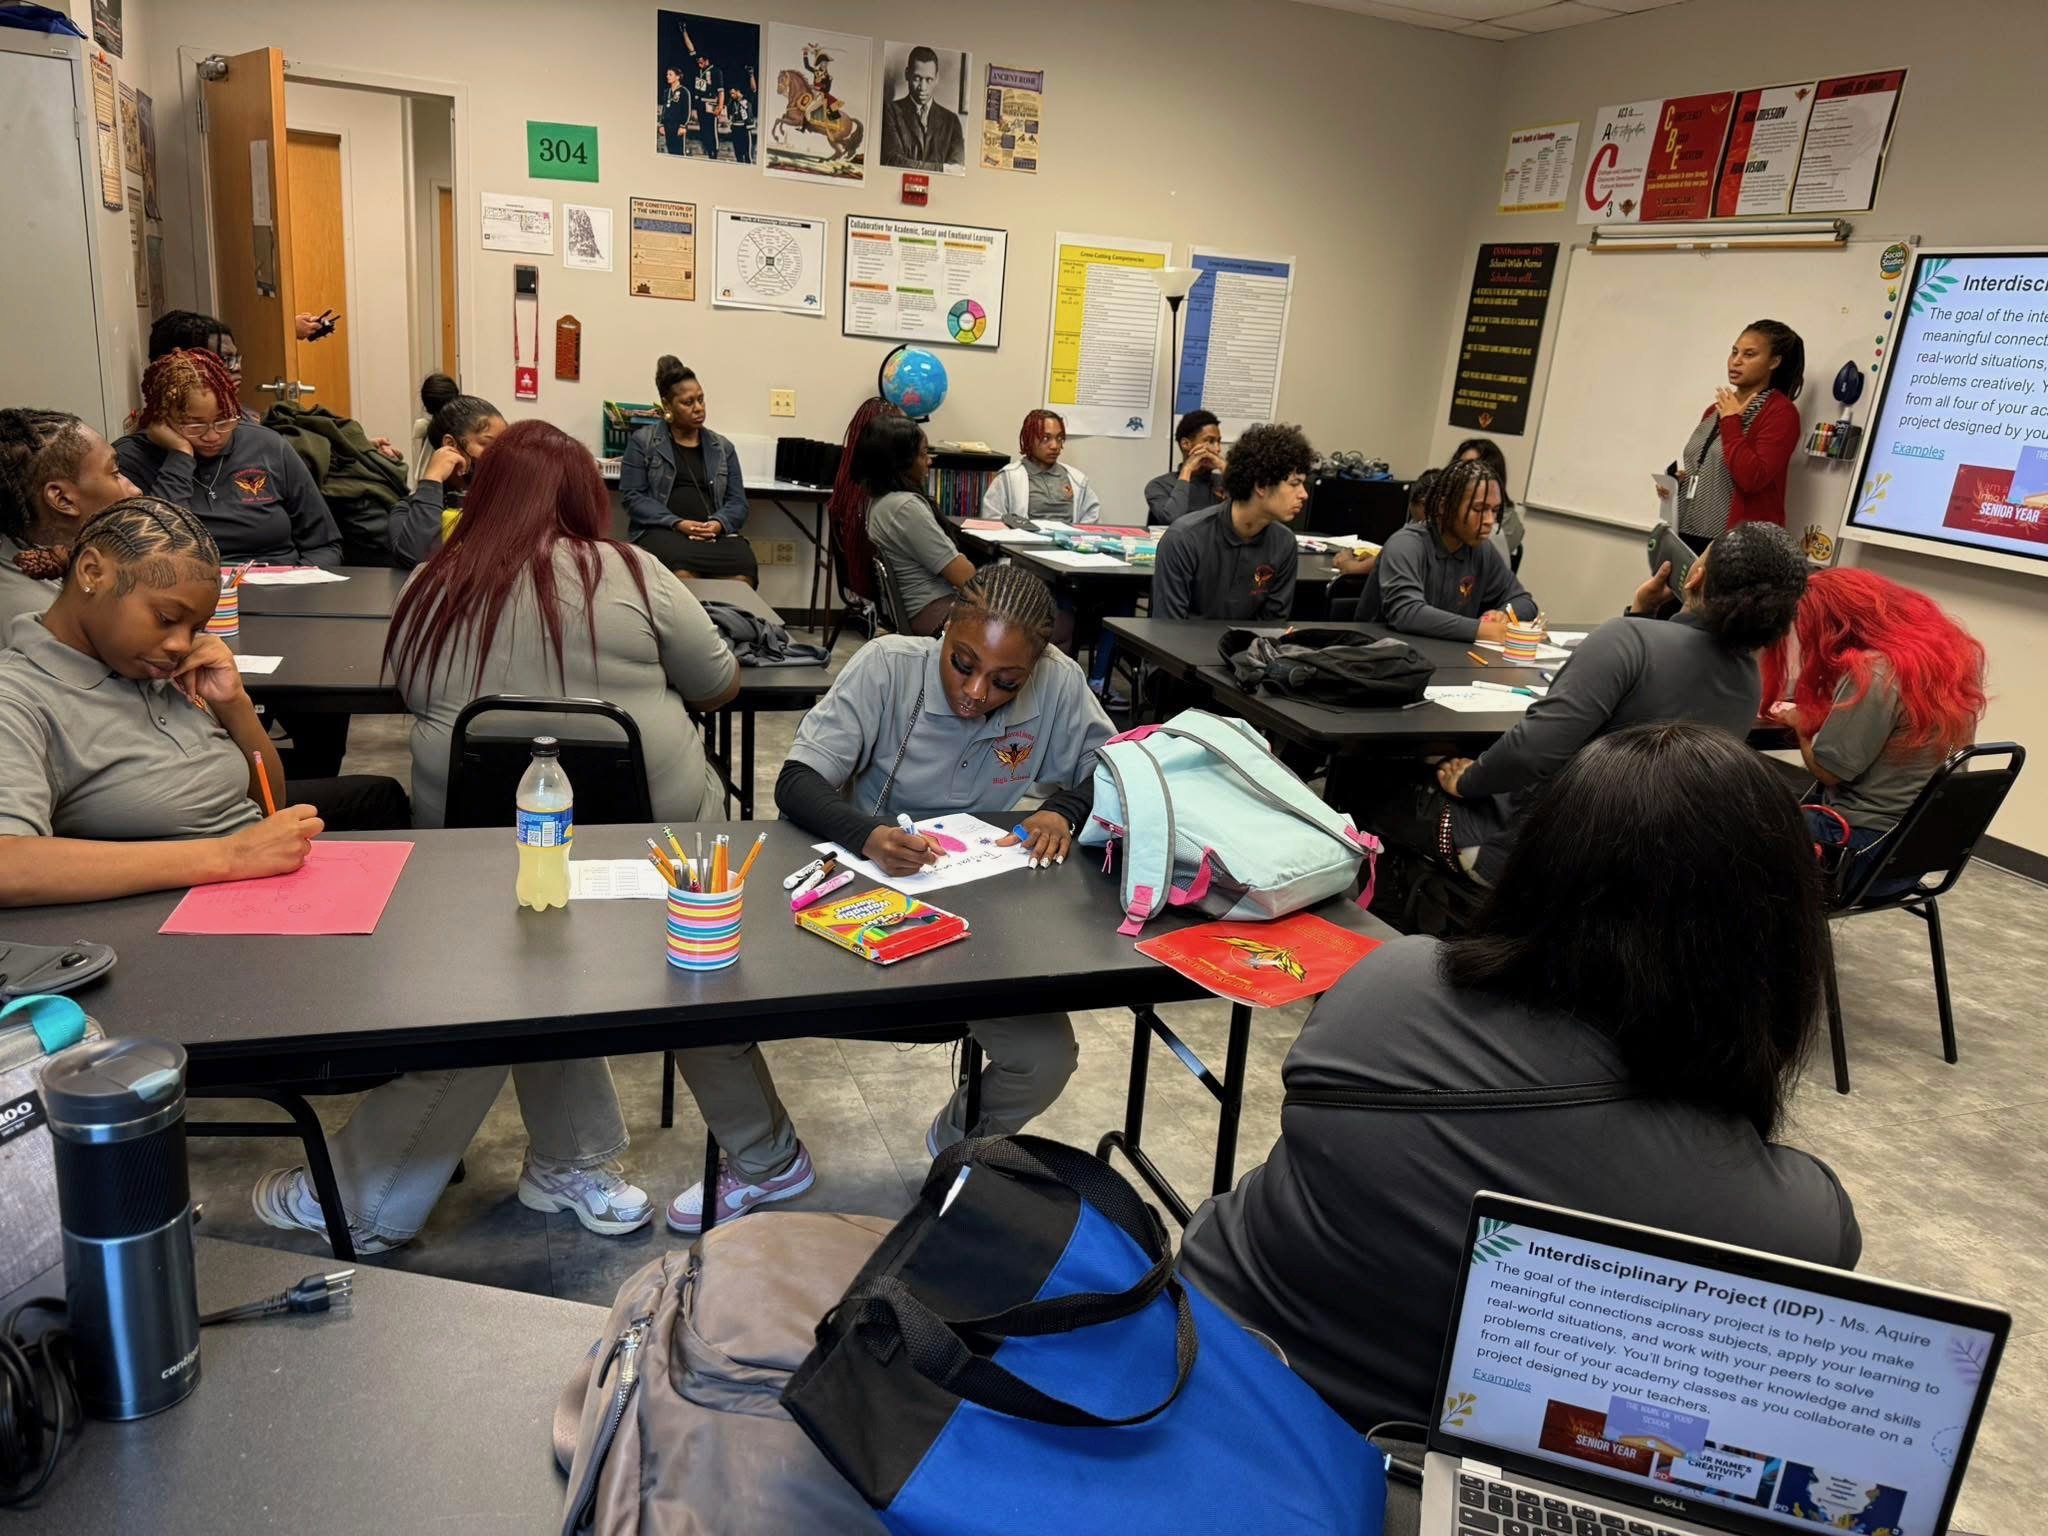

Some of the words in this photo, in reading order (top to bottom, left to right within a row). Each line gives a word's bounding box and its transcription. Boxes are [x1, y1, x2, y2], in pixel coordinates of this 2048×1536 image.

[1756, 106, 1788, 121] MISSION
[540, 138, 588, 165] 304
[1745, 160, 1768, 173] VISION
[850, 220, 884, 232] Collaborative
[894, 225, 920, 236] Academic,
[922, 228, 936, 236] Social
[938, 230, 946, 238] and
[948, 230, 972, 240] Emotional
[973, 233, 994, 244] Learning
[1112, 254, 1144, 263] Competencies
[1930, 306, 1952, 320] The
[1955, 308, 1984, 323] goal
[1987, 308, 2000, 322] of
[2003, 310, 2024, 322] the
[1922, 330, 1992, 346] meaningful
[1995, 333, 2048, 346] connect
[1916, 352, 1978, 366] real-world
[1981, 354, 2048, 371] situations,
[1910, 372, 1967, 386] problems
[1970, 375, 2036, 394] creatively.
[1905, 392, 1932, 406] from
[1936, 394, 1950, 408] all
[1953, 395, 1978, 410] four
[1982, 399, 1995, 411] of
[1996, 402, 2028, 416] your
[2030, 405, 2048, 416] ac
[1899, 416, 1941, 429] project
[1944, 419, 2002, 434] designed
[2005, 424, 2022, 440] by
[1891, 441, 1946, 460] Examples
[1980, 502, 2014, 520] SENIOR
[2015, 507, 2040, 522] YEAR
[1528, 1242, 1688, 1293] Interdisciplinary
[1694, 1280, 1768, 1310] Project
[1773, 1298, 1824, 1325] (IDP)
[1840, 1316, 1869, 1334] Ms.
[1875, 1325, 1931, 1347] Aquire
[1495, 1261, 1520, 1276] The
[1524, 1268, 1554, 1284] goal
[1558, 1277, 1572, 1288] of
[1576, 1281, 1596, 1294] the
[1600, 1286, 1710, 1325] interdisciplinary
[1714, 1314, 1764, 1334] project
[1768, 1326, 1780, 1338] is
[1786, 1330, 1799, 1342] to
[1804, 1334, 1836, 1352] help
[1840, 1343, 1867, 1360] you
[1872, 1352, 1914, 1370] make
[1487, 1296, 1554, 1320] real-world
[1558, 1312, 1626, 1340] situations,
[1632, 1330, 1658, 1346] and
[1662, 1336, 1696, 1355] work
[1701, 1348, 1729, 1363] with
[1734, 1356, 1766, 1372] your
[1770, 1364, 1812, 1384] peers
[1816, 1374, 1830, 1388] to
[1834, 1380, 1874, 1398] solve
[1490, 1278, 1566, 1306] meaningful
[1569, 1298, 1652, 1326] connections
[1657, 1320, 1704, 1338] across
[1708, 1331, 1772, 1357] subjects,
[1777, 1348, 1818, 1368] apply
[1823, 1358, 1856, 1376] your
[1860, 1366, 1921, 1394] learning
[1926, 1380, 1940, 1396] to
[1472, 1368, 1532, 1393] Examples
[1476, 1346, 1522, 1366] project
[1526, 1357, 1588, 1384] designed
[1592, 1374, 1608, 1390] by
[1612, 1380, 1644, 1398] your
[1647, 1388, 1711, 1414] teachers.
[1484, 1313, 1546, 1336] problems
[1550, 1328, 1616, 1356] creatively.
[1664, 1356, 1700, 1377] bring
[1704, 1366, 1764, 1392] together
[1768, 1382, 1847, 1412] knowledge
[1851, 1403, 1880, 1418] and
[1884, 1412, 1922, 1429] skills
[1480, 1329, 1510, 1345] from
[1514, 1336, 1530, 1350] all
[1534, 1342, 1560, 1357] four
[1564, 1350, 1578, 1362] of
[1581, 1354, 1612, 1371] your
[1615, 1362, 1684, 1390] academy
[1683, 1380, 1736, 1402] classes
[1741, 1396, 1758, 1408] as
[1762, 1400, 1790, 1416] you
[1793, 1408, 1875, 1436] collaborate
[1880, 1430, 1899, 1444] on
[1904, 1436, 1914, 1446] a
[1576, 1434, 1610, 1451] SENIOR
[1612, 1444, 1638, 1459] YEAR
[1688, 1460, 1746, 1479] CREATIVITY
[1706, 1472, 1724, 1480] KIT
[1715, 1458, 1752, 1473] NAME'S
[1654, 1496, 1686, 1511] DELL
